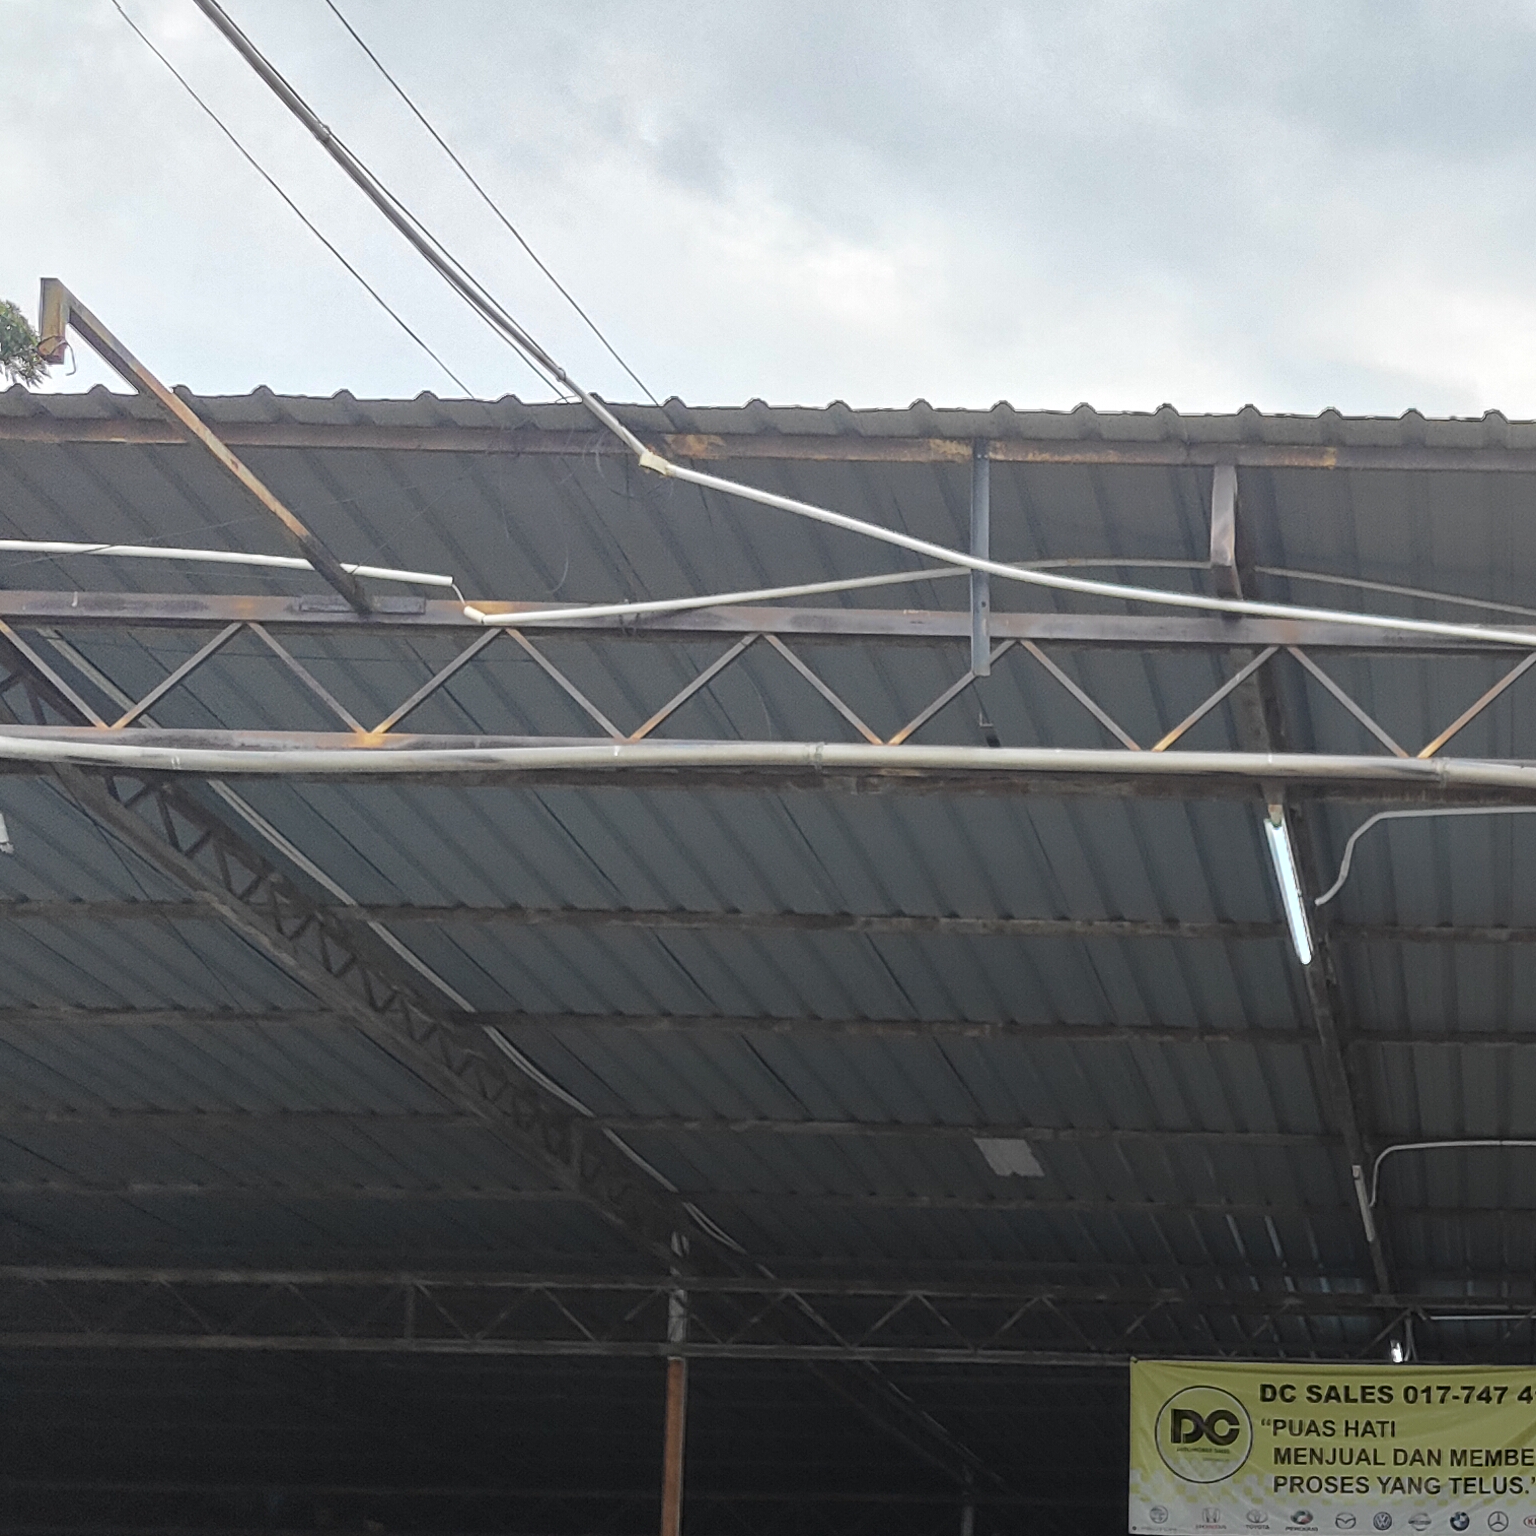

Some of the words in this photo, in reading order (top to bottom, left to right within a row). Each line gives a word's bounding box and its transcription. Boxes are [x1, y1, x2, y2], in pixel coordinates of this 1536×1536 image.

[1260, 1384, 1296, 1403] DC
[1306, 1385, 1394, 1404] SALES
[1403, 1385, 1508, 1404] 017-747
[1170, 1408, 1240, 1446] DC
[1344, 1420, 1396, 1438] HATI
[1273, 1447, 1386, 1466] MENJUAL
[1393, 1448, 1442, 1467] DAN
[1273, 1475, 1370, 1494] PROSES
[1377, 1476, 1441, 1495] YANG
